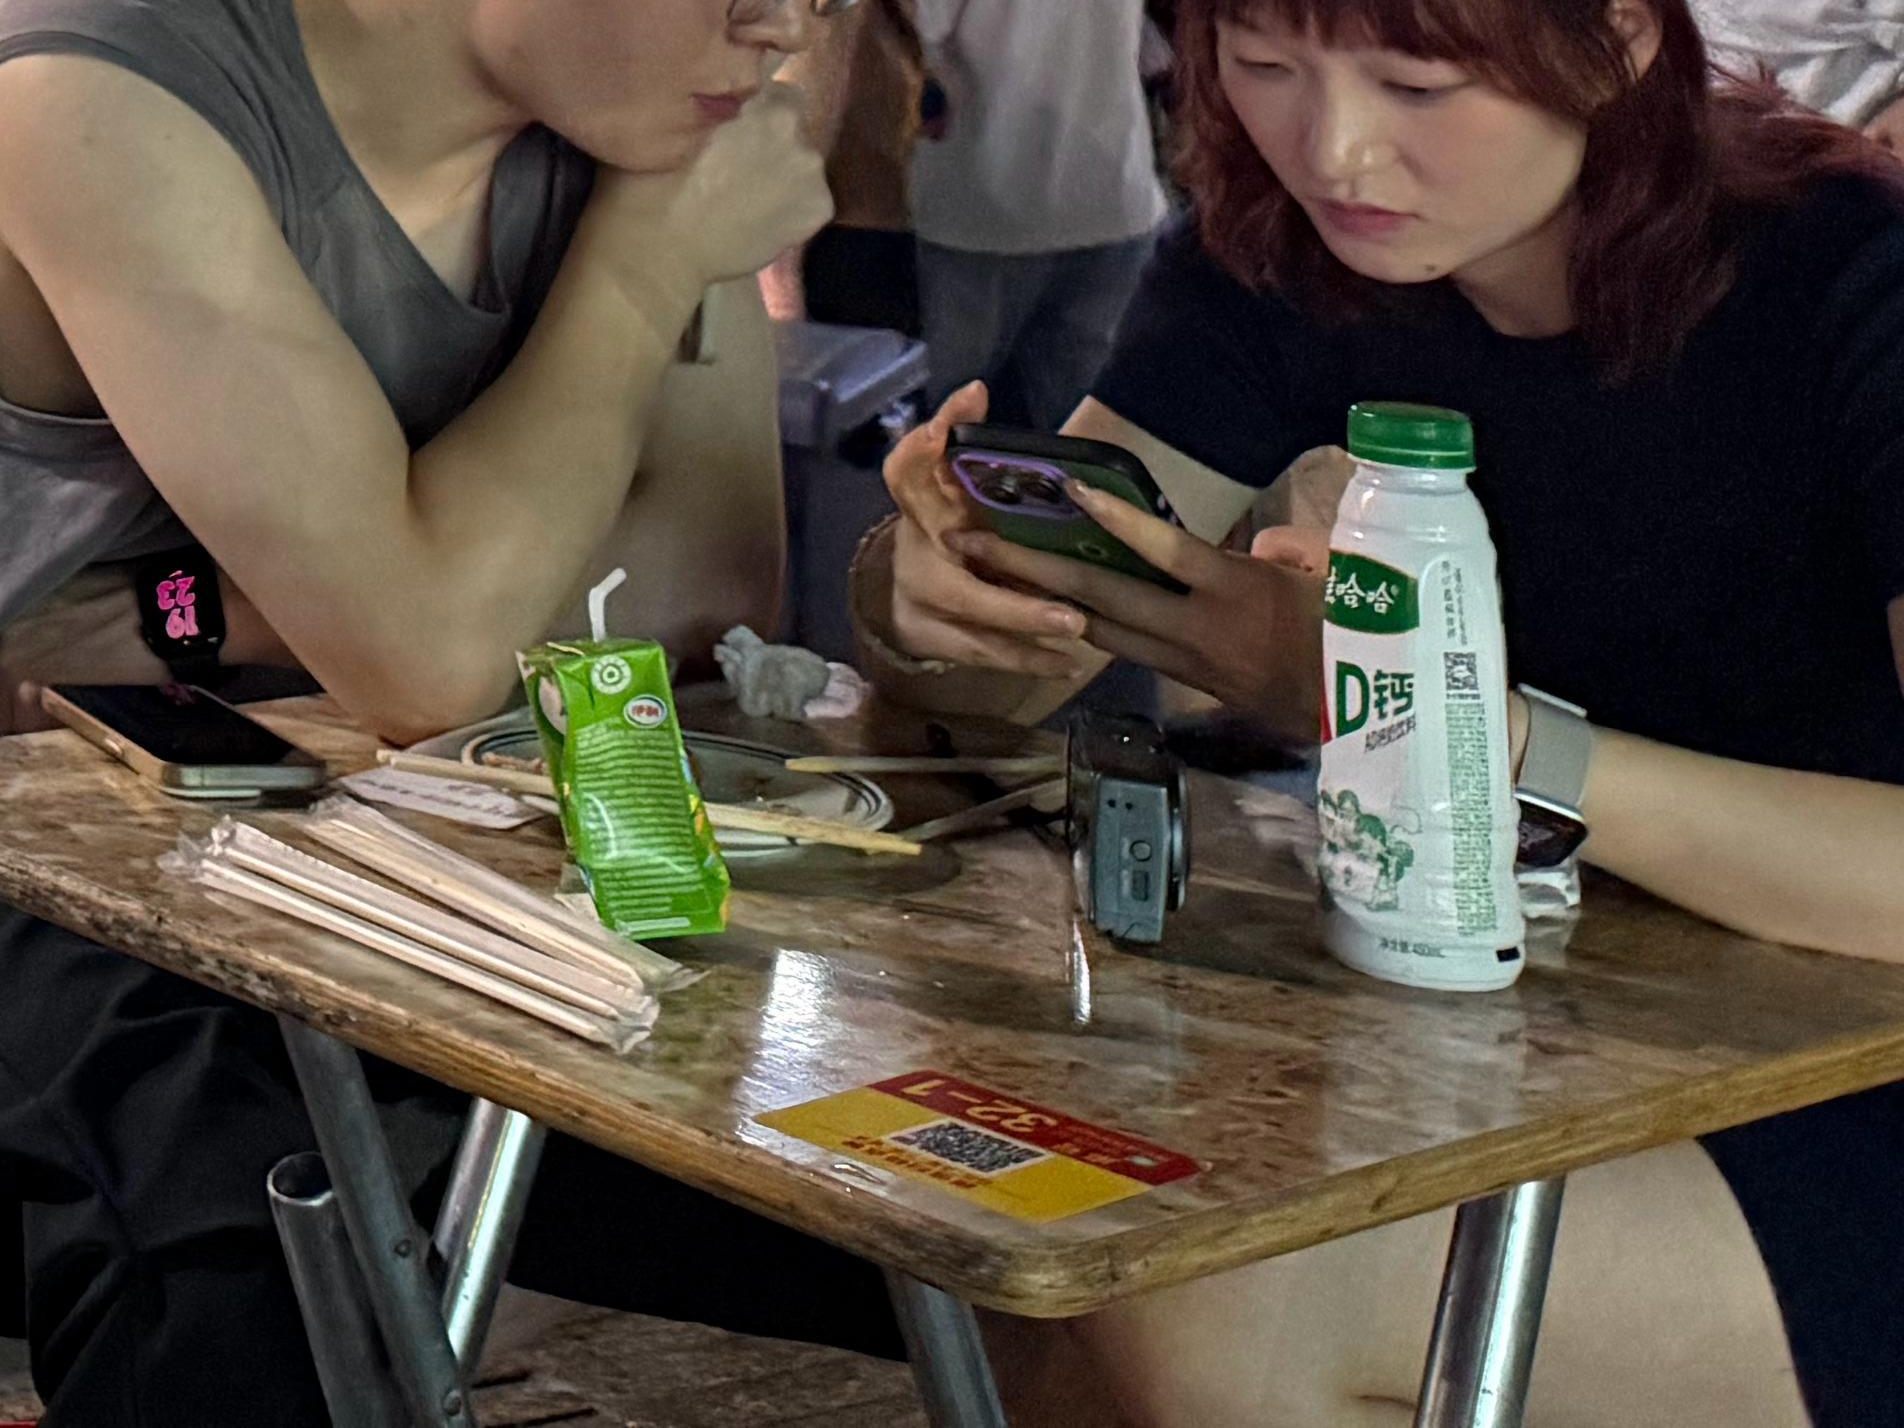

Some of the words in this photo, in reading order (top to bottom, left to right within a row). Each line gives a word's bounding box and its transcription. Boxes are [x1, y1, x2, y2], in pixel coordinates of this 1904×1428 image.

[156, 575, 196, 610] 23
[164, 605, 200, 640] 19
[900, 1078, 1059, 1133] 32-1
